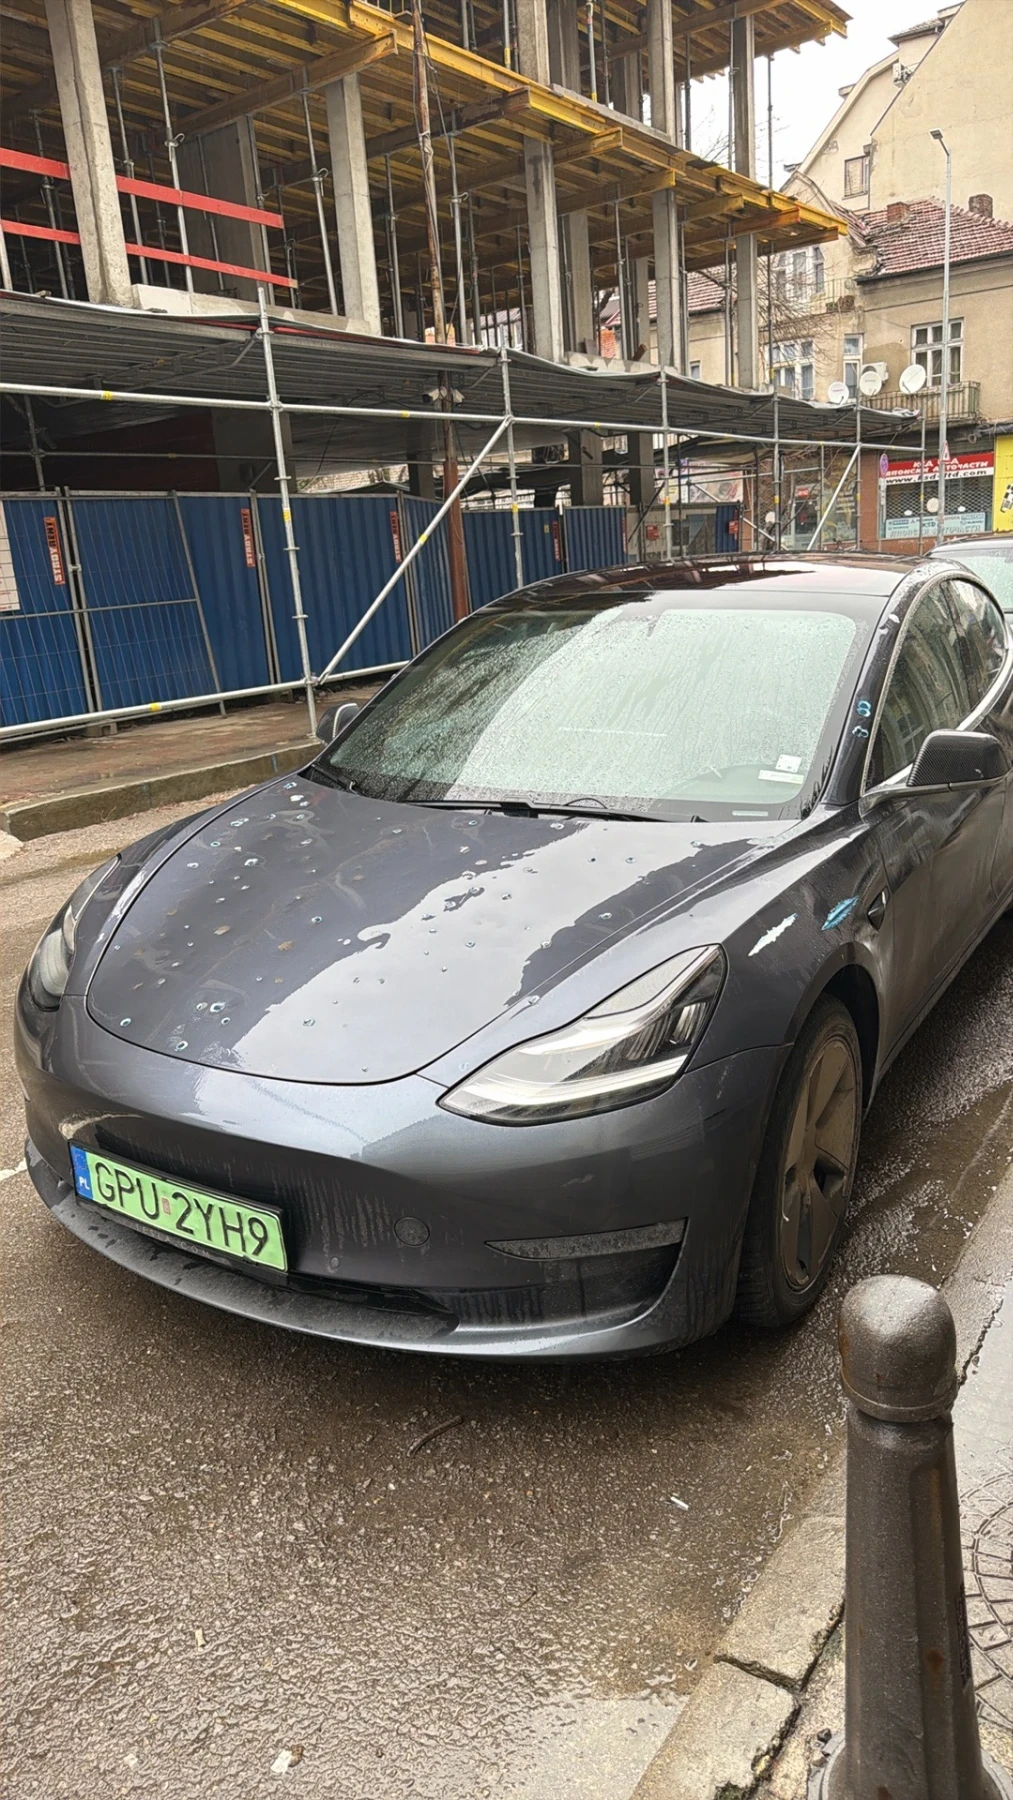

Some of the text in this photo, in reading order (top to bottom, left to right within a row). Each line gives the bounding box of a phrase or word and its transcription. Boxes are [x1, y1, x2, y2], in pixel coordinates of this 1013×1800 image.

[932, 461, 988, 473] АТОЧАСТИ
[46, 521, 62, 582] STROYRENT
[79, 1176, 90, 1190] PL
[95, 1162, 269, 1257] GPU 2YH9
